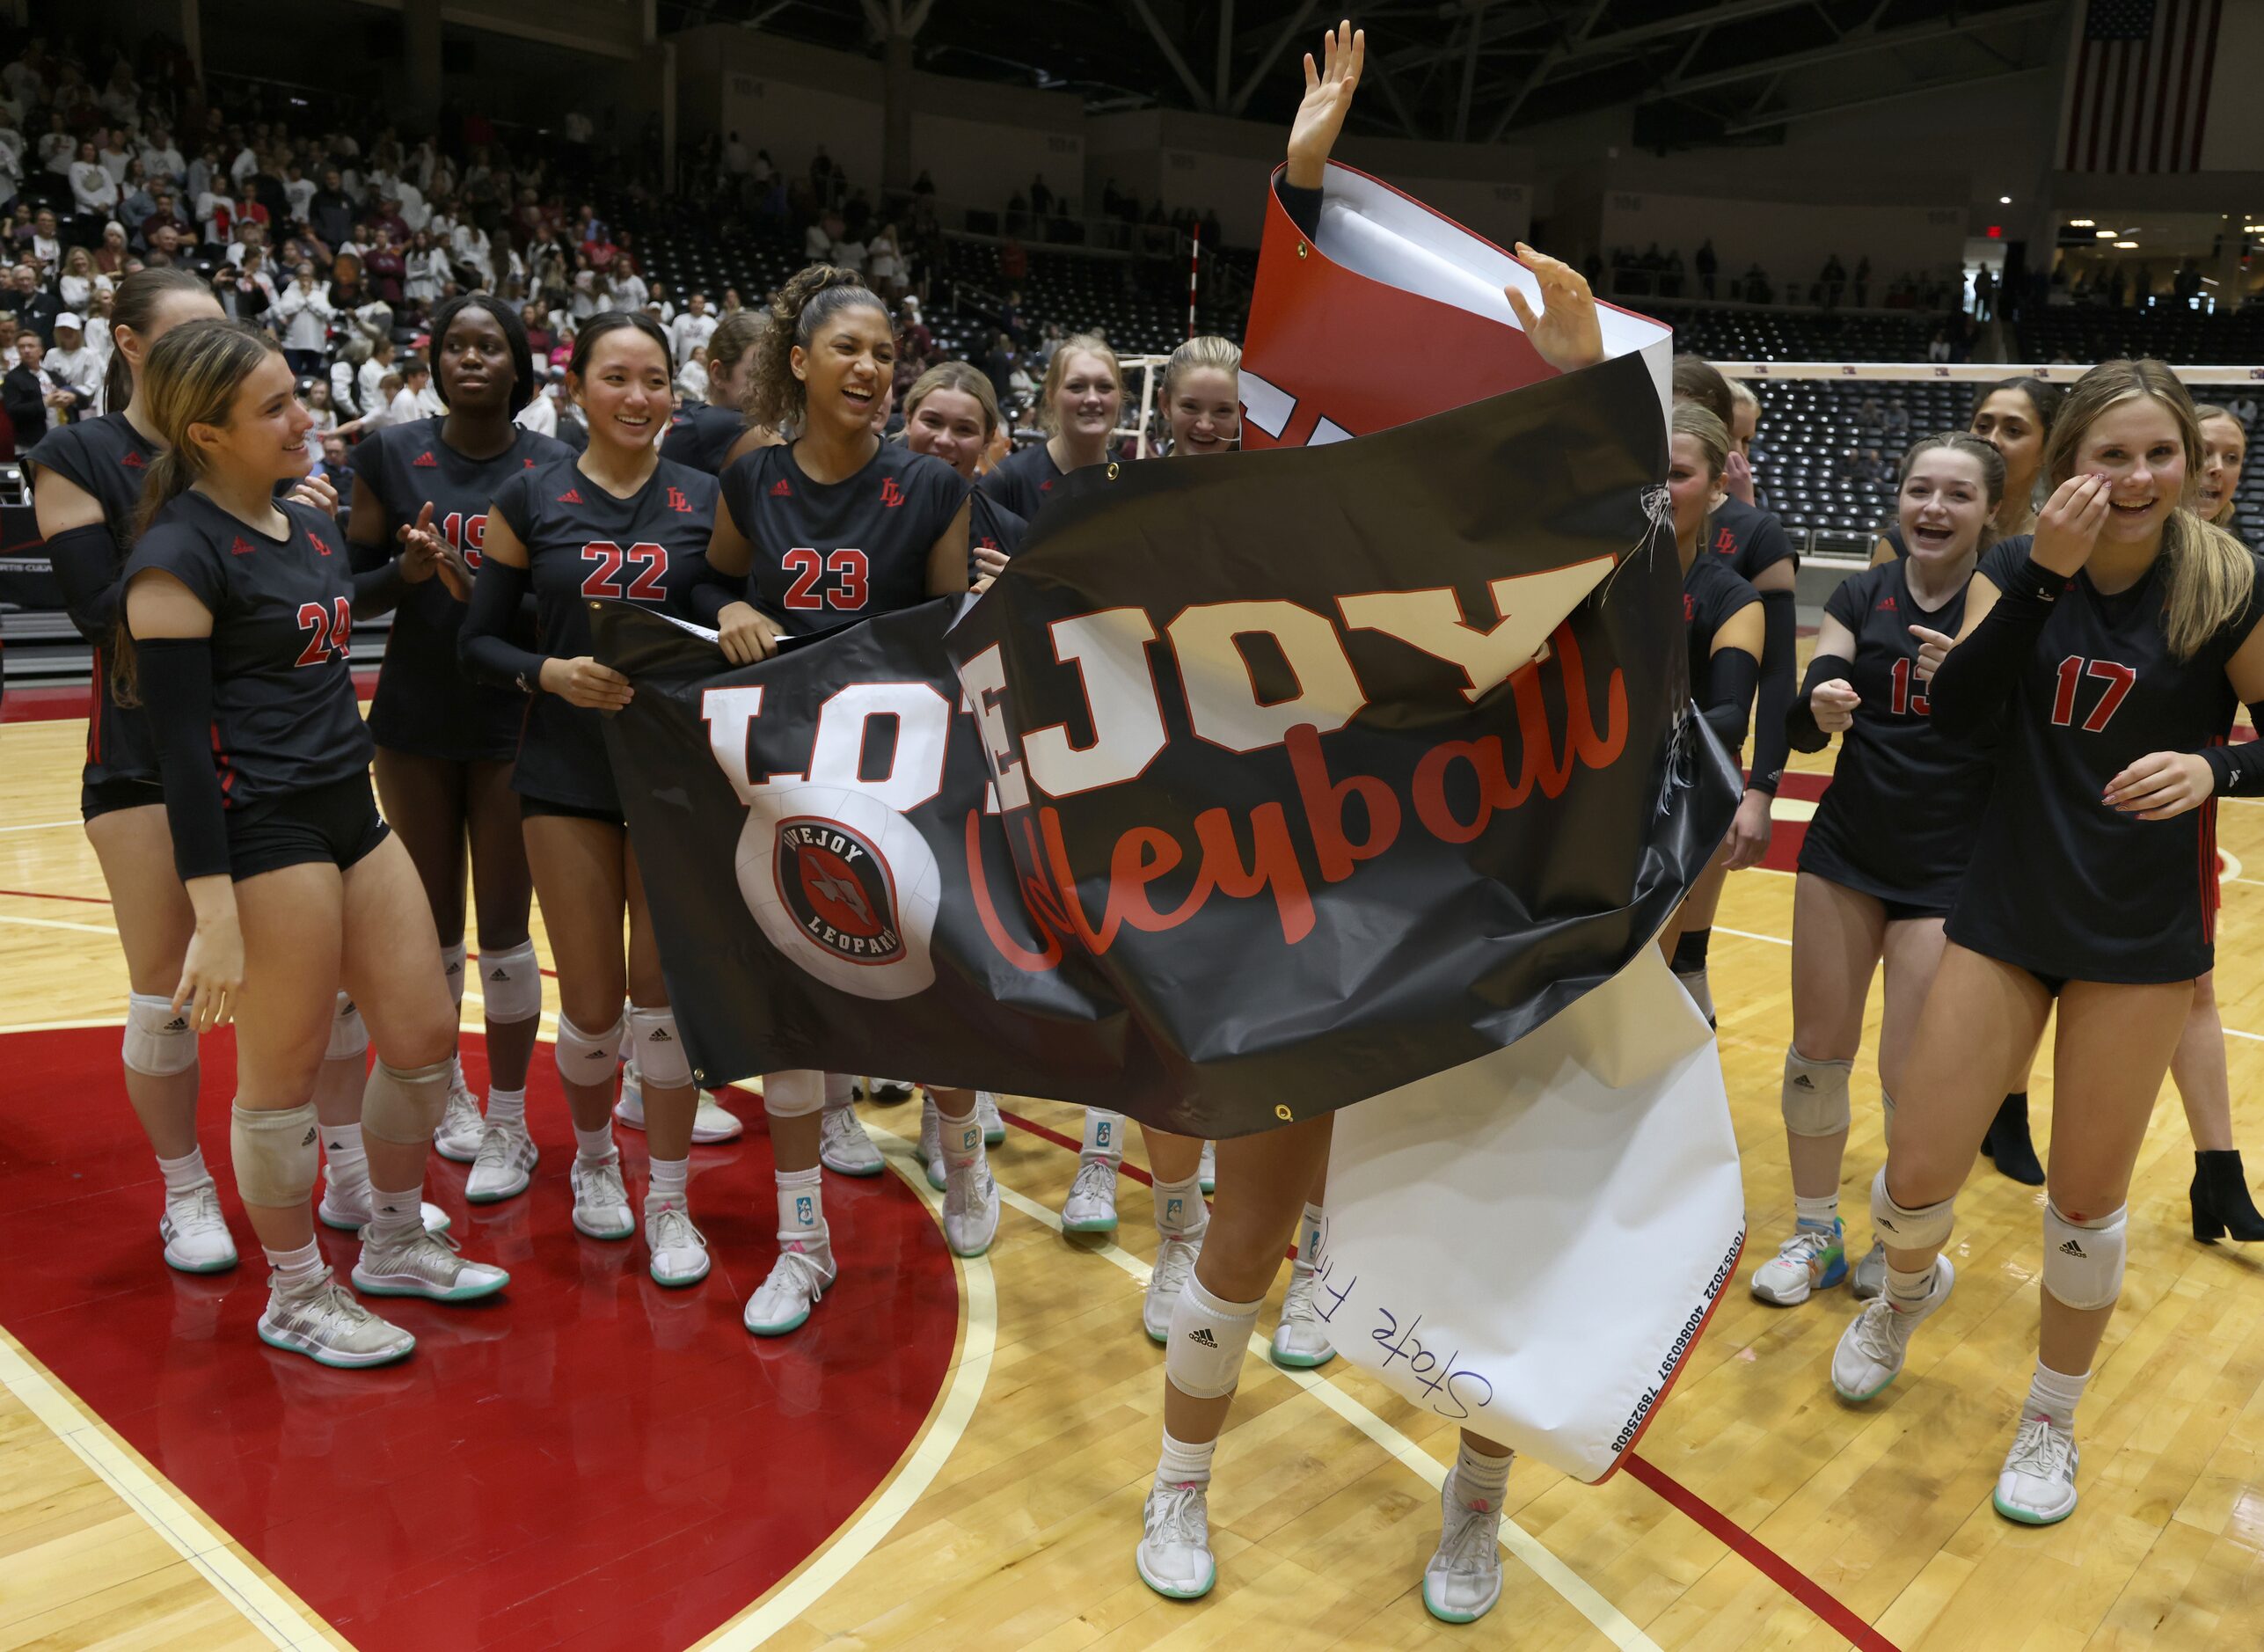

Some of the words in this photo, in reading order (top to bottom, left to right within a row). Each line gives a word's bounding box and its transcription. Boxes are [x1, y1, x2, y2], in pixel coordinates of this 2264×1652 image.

[442, 512, 488, 569] 19
[581, 540, 668, 602] 22
[781, 547, 869, 610] 23
[295, 596, 351, 667] 24
[701, 552, 1618, 815] LOEJOY
[2051, 654, 2136, 733] 17
[2059, 1245, 2087, 1260] adidas
[1188, 1332, 1219, 1349] adidas
[1371, 1307, 1494, 1419] State
[1656, 1304, 1705, 1381] 400860397
[1610, 1385, 1659, 1453] 78925808
